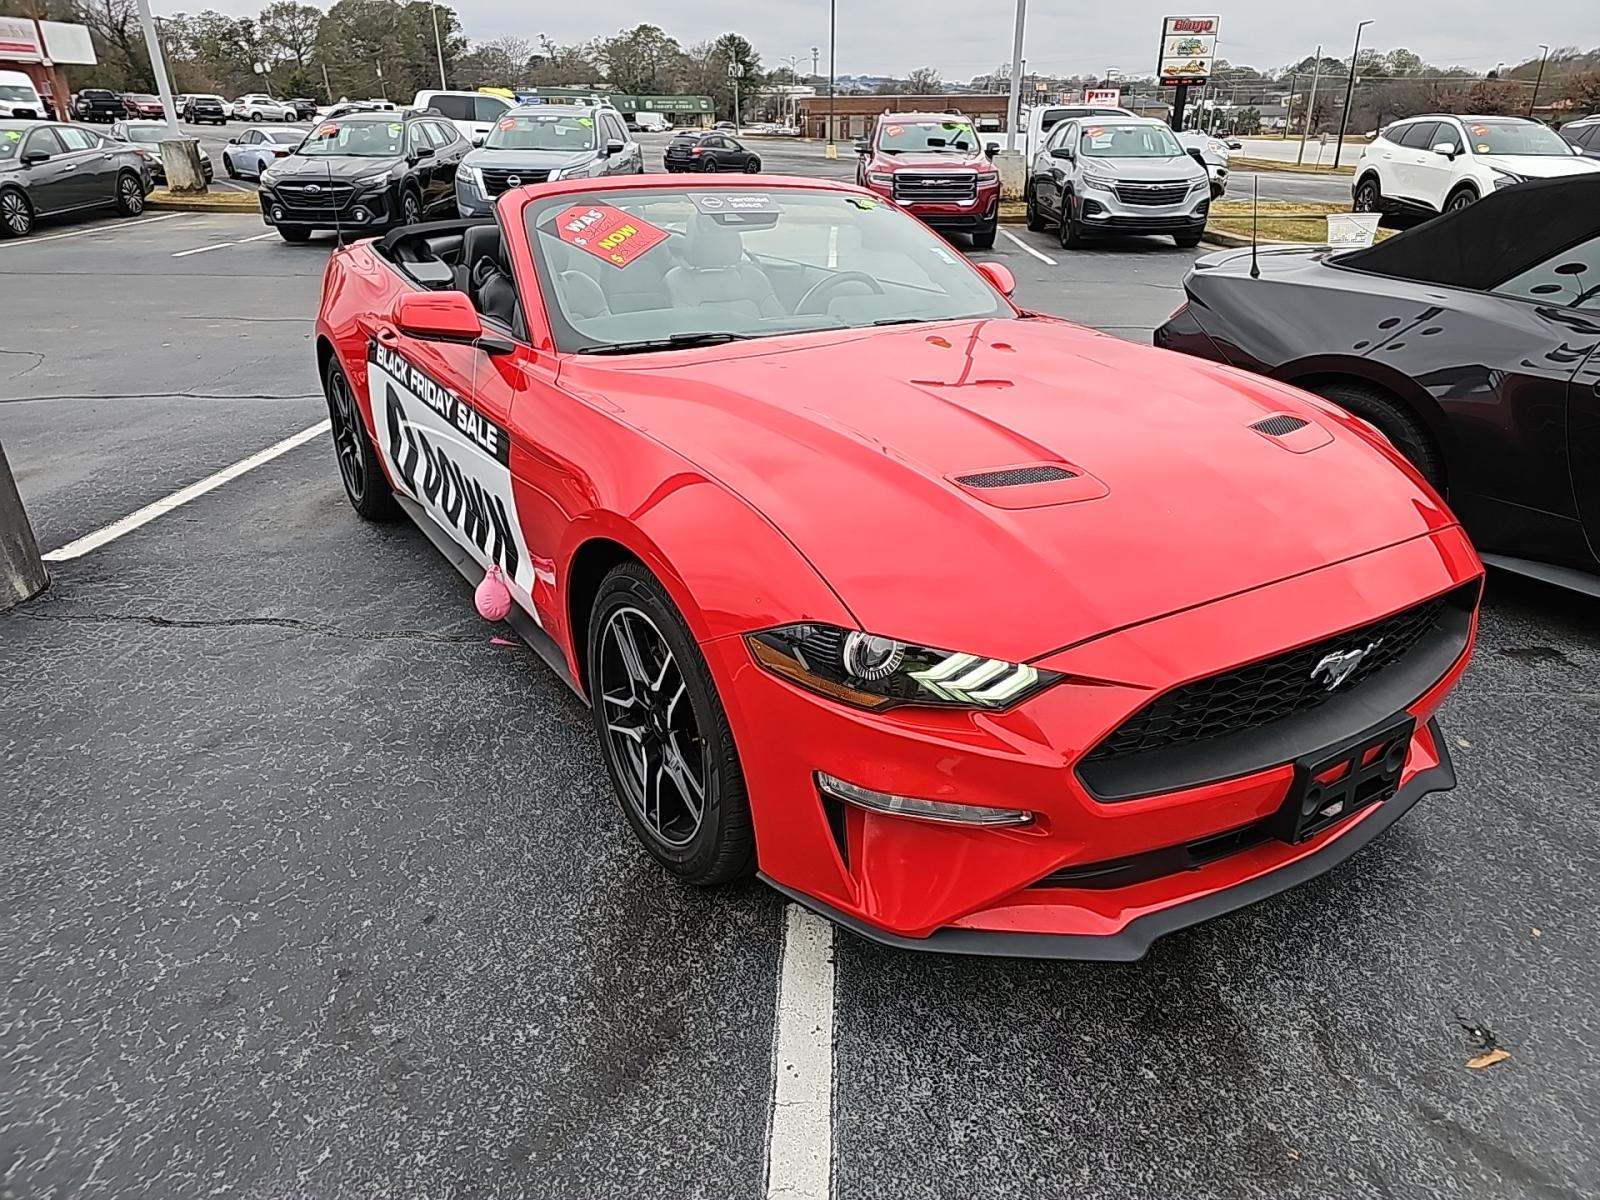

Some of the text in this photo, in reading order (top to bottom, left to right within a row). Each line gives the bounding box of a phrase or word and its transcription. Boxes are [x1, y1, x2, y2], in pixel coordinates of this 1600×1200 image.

[1173, 20, 1213, 33] Bingo
[726, 196, 770, 204] Certified
[564, 208, 604, 233] WAS
[598, 223, 638, 251] NOW
[377, 344, 498, 455] BLACK FRIDAY SALE
[416, 428, 520, 586] DOWN
